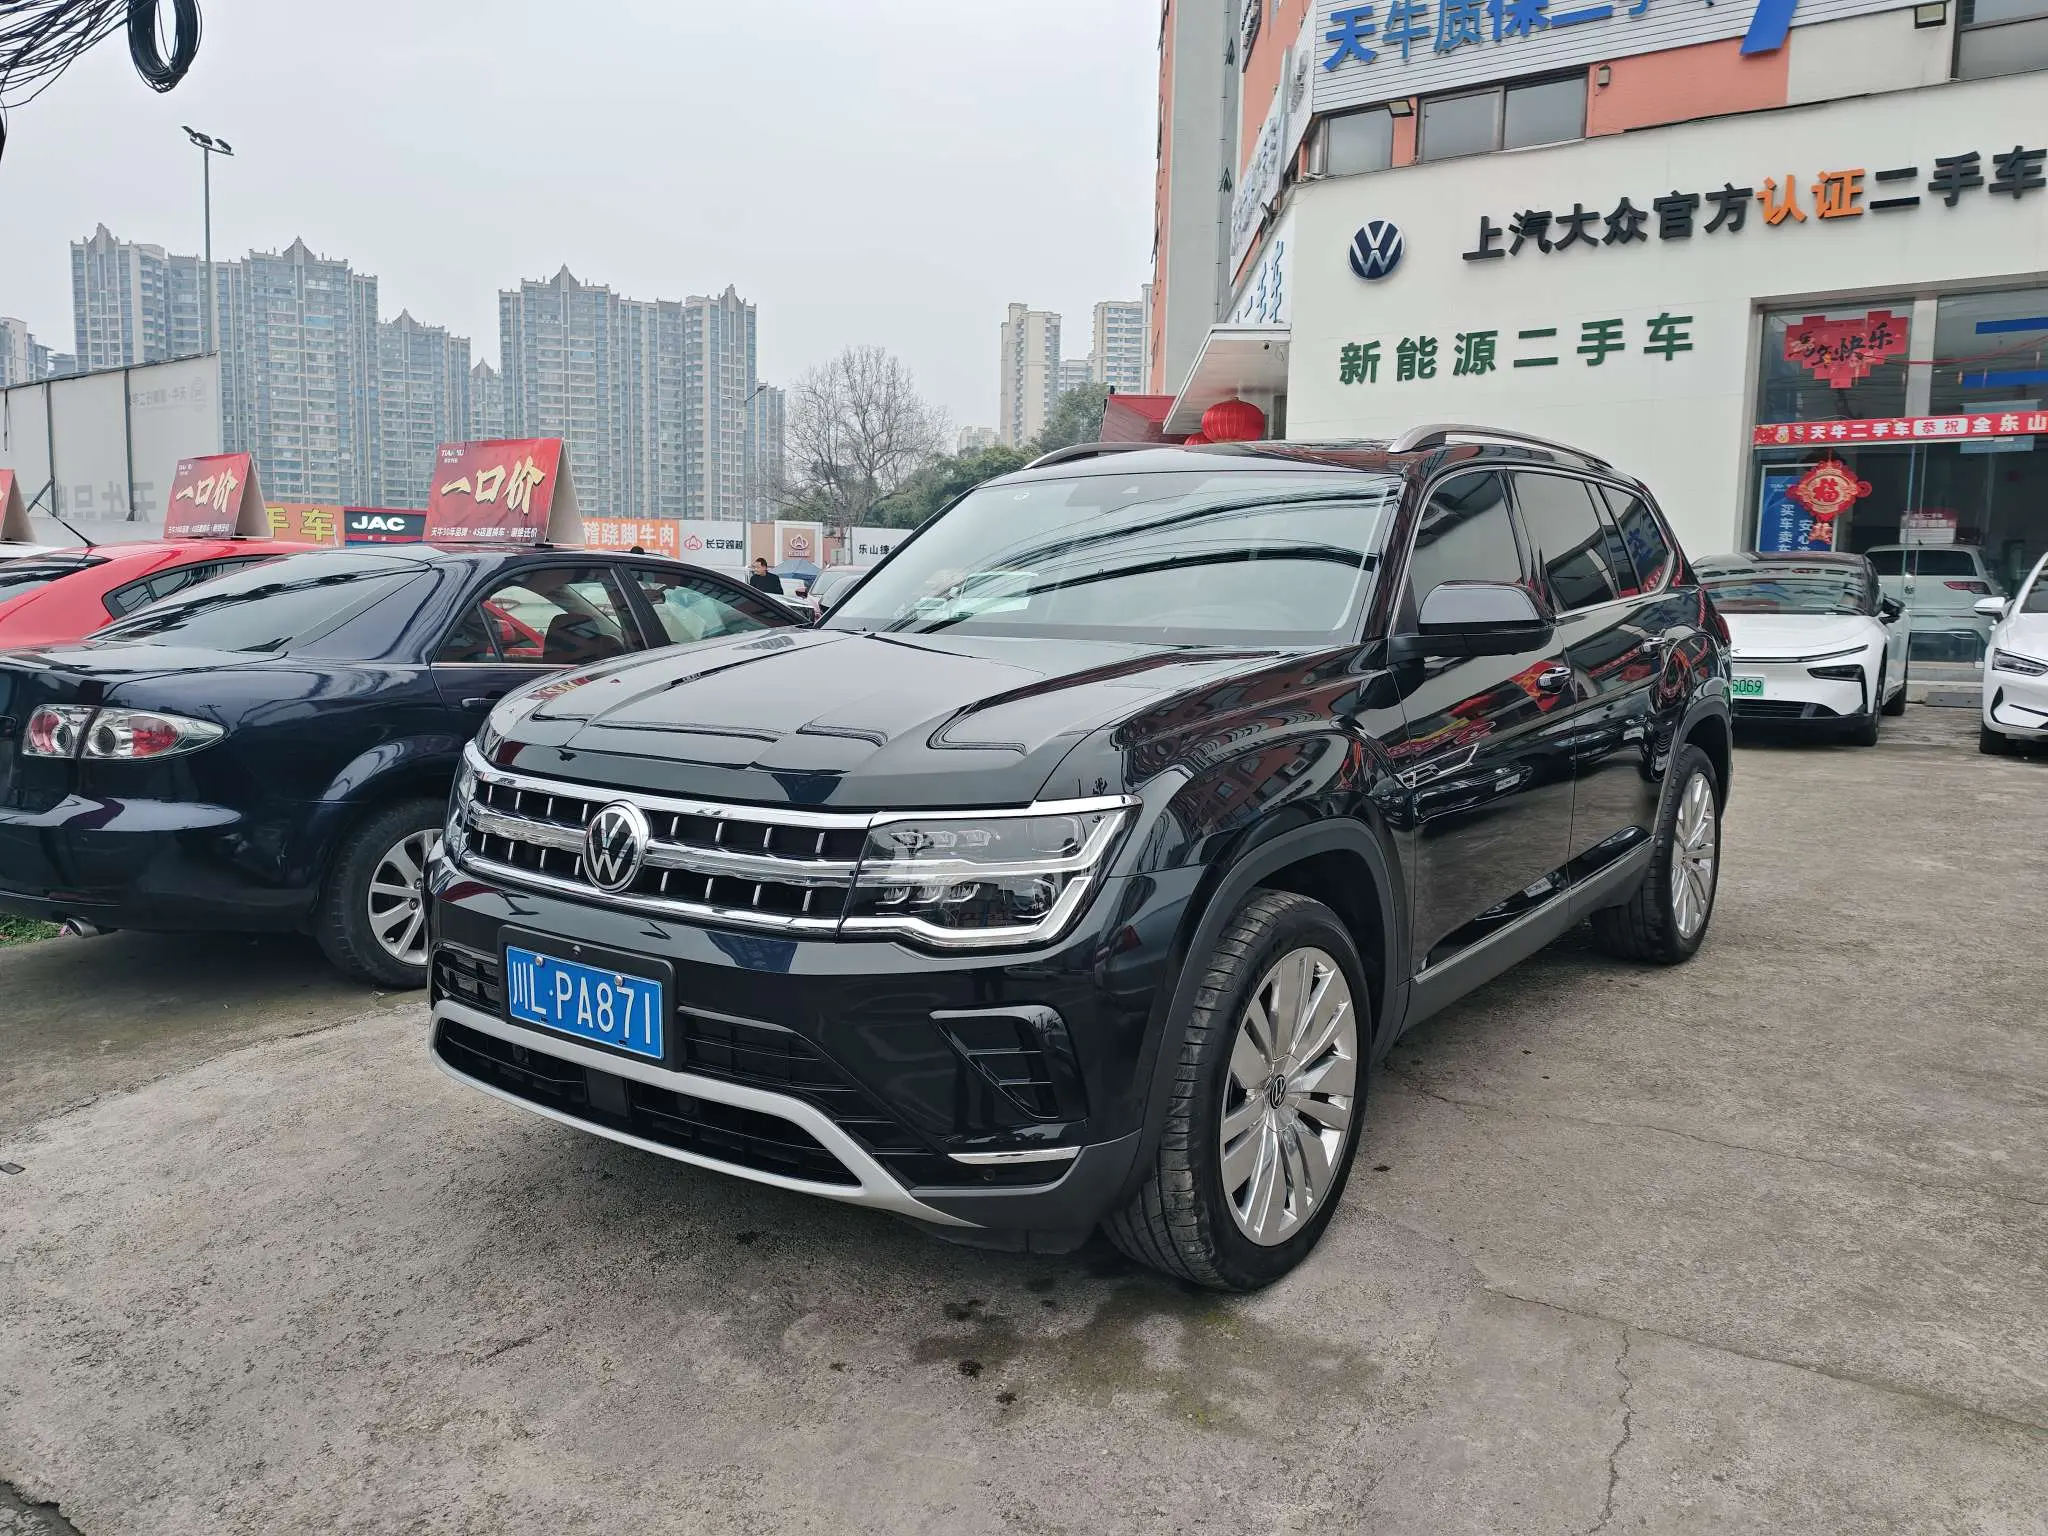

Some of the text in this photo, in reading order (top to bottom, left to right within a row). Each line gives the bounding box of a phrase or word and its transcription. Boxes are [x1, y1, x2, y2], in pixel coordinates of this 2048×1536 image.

[1322, 0, 1650, 72] 天牛质保
[1463, 145, 2047, 262] 上汽大众官方认证二手车
[1339, 312, 1695, 387] 新能源二手车
[176, 467, 239, 513] 一口价
[440, 456, 546, 516] 一口价
[351, 515, 406, 532] JAC
